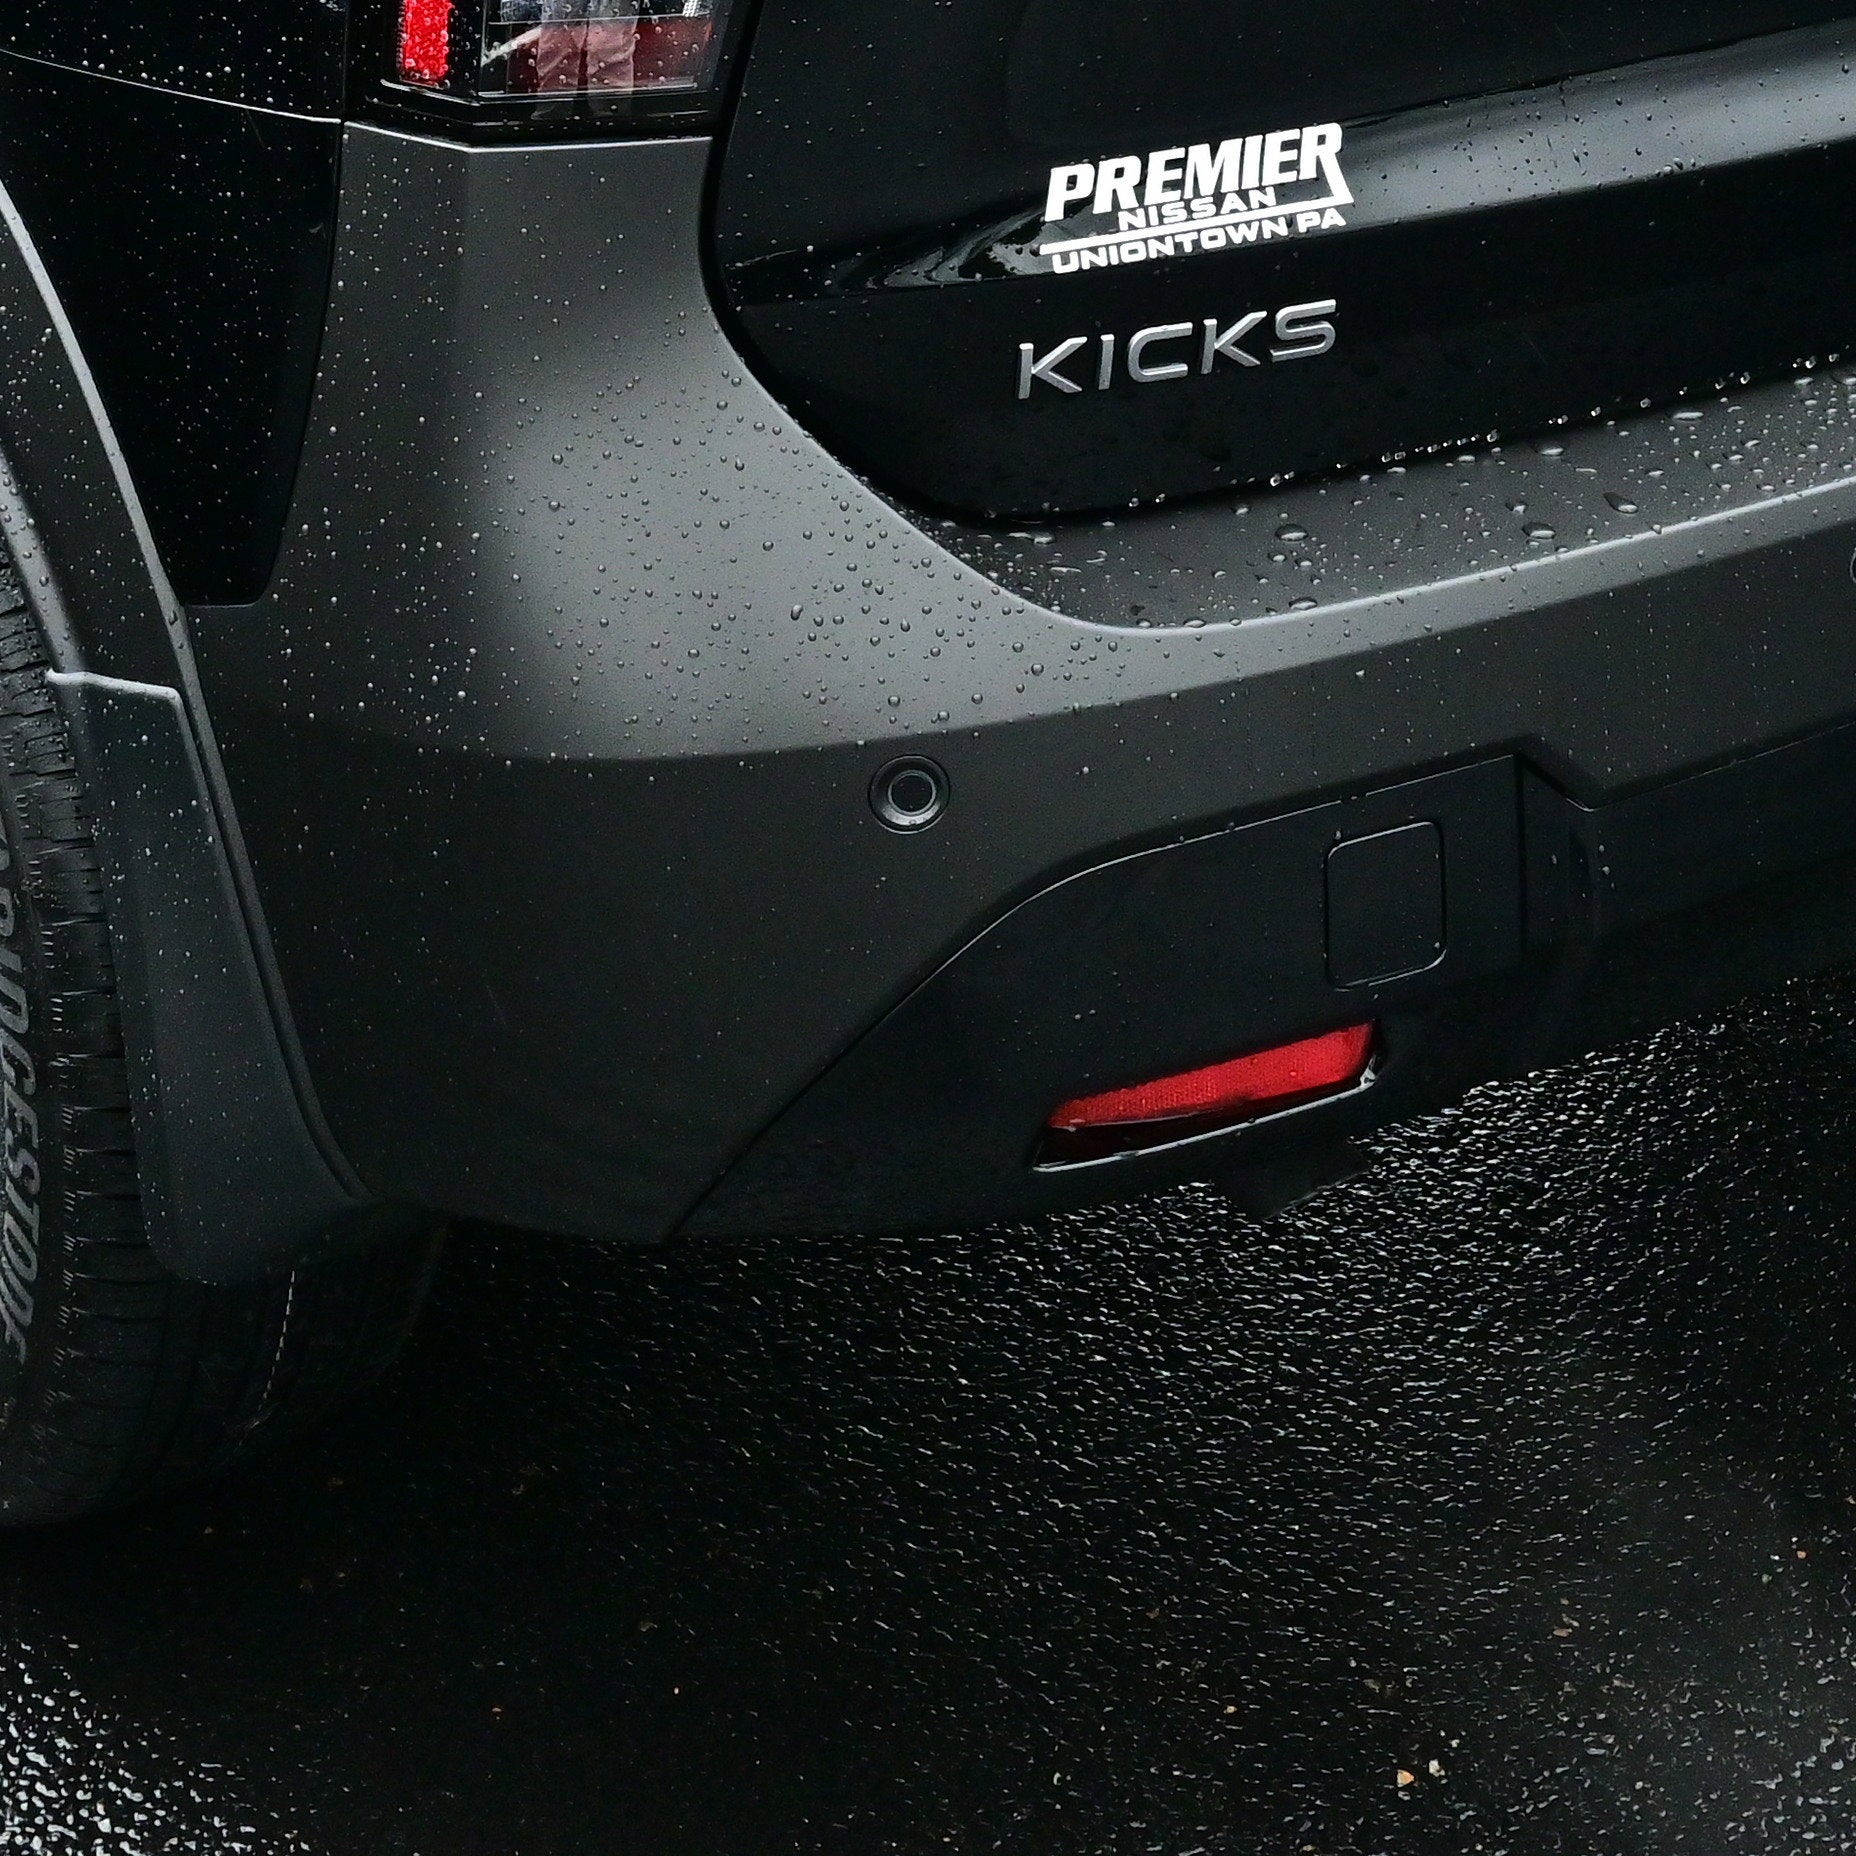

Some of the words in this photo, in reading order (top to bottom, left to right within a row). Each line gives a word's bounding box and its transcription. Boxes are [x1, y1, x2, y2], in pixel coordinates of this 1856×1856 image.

[1044, 122, 1354, 222] PREMIER
[1118, 186, 1277, 231] NISSAN
[1051, 216, 1288, 274] UNIONTOWN
[1296, 207, 1347, 233] PA
[1017, 298, 1337, 400] KICKS
